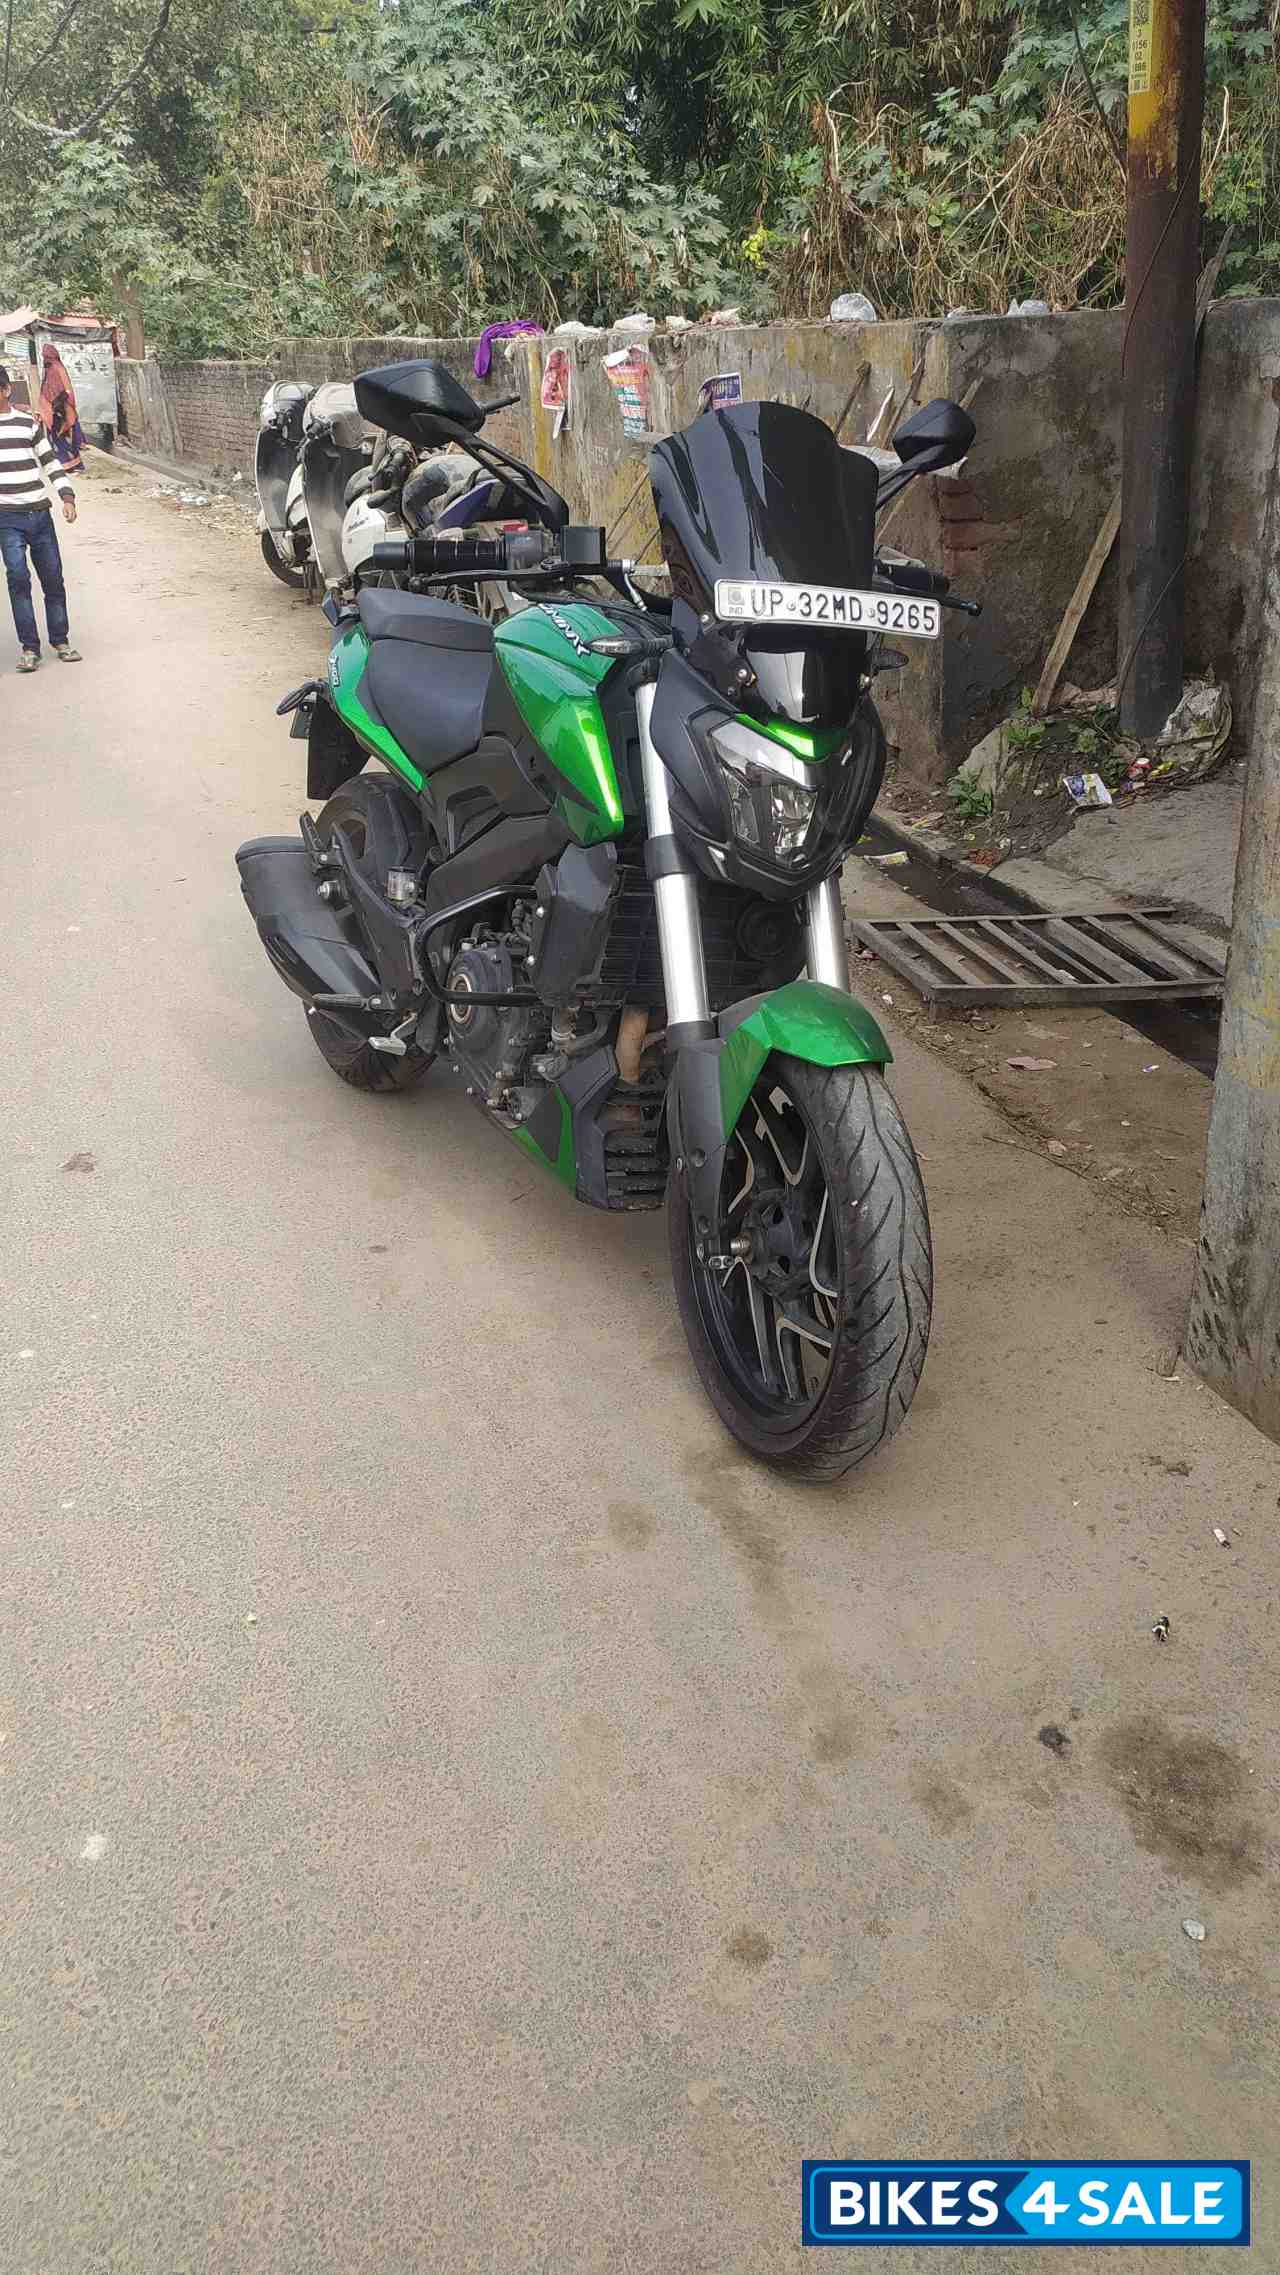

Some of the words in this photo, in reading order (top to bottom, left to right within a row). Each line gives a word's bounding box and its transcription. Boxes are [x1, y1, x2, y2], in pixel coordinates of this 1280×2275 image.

[751, 588, 784, 617] UP
[799, 591, 862, 621] 32MD
[877, 600, 935, 632] 9265
